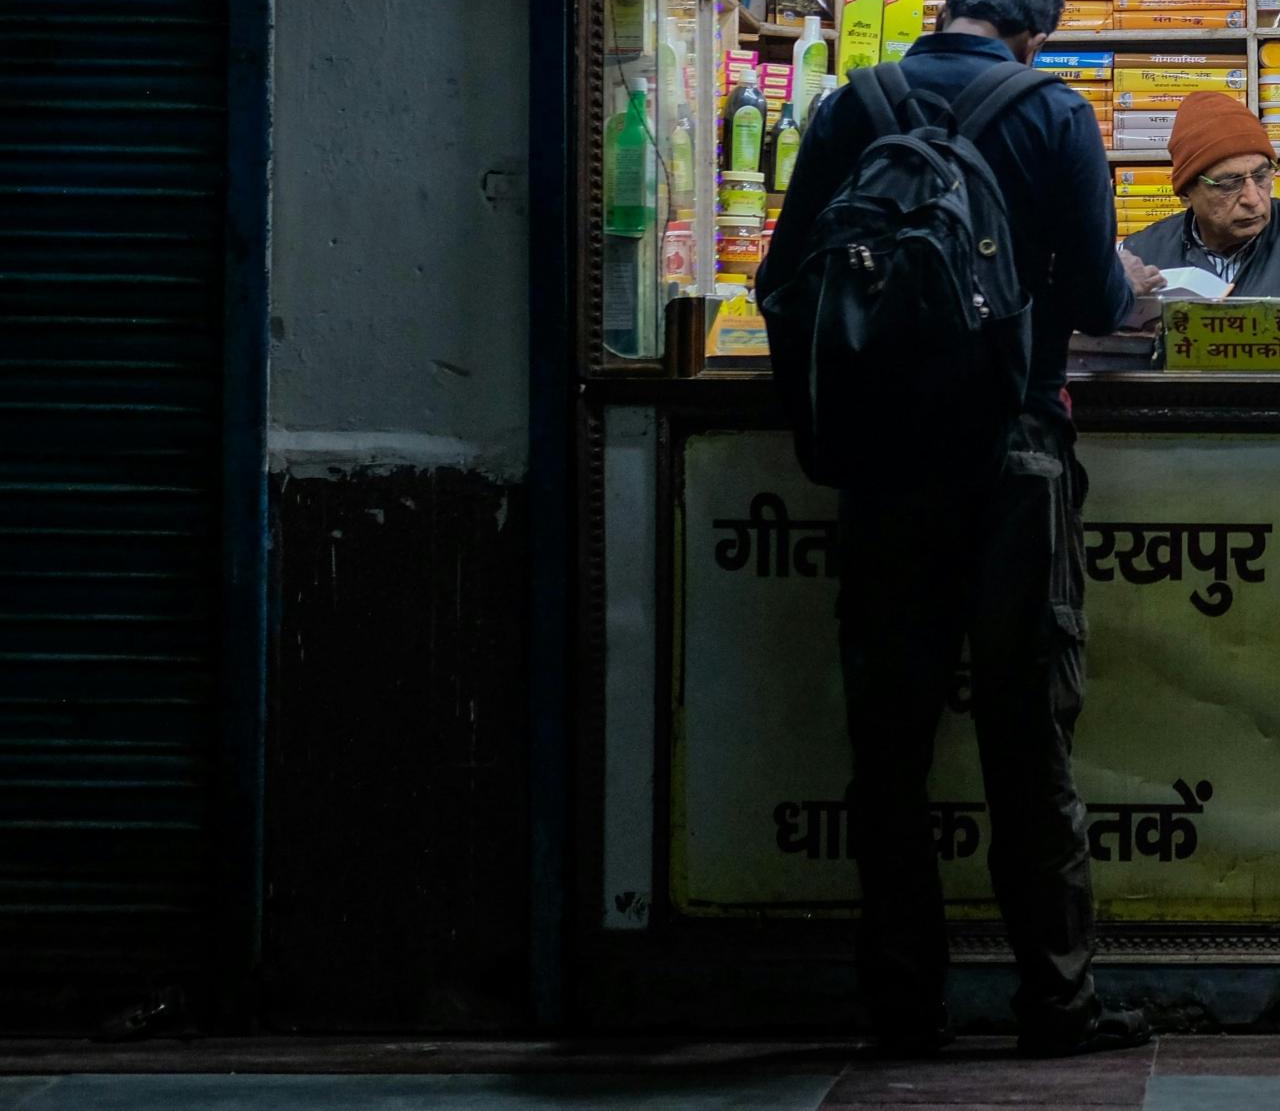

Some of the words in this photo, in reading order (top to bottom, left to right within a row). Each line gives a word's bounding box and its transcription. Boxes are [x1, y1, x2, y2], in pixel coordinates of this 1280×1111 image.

[1200, 313, 1258, 337] नाथ!
[1083, 522, 1274, 618] रखपुर
[1086, 777, 1214, 862] तकें
